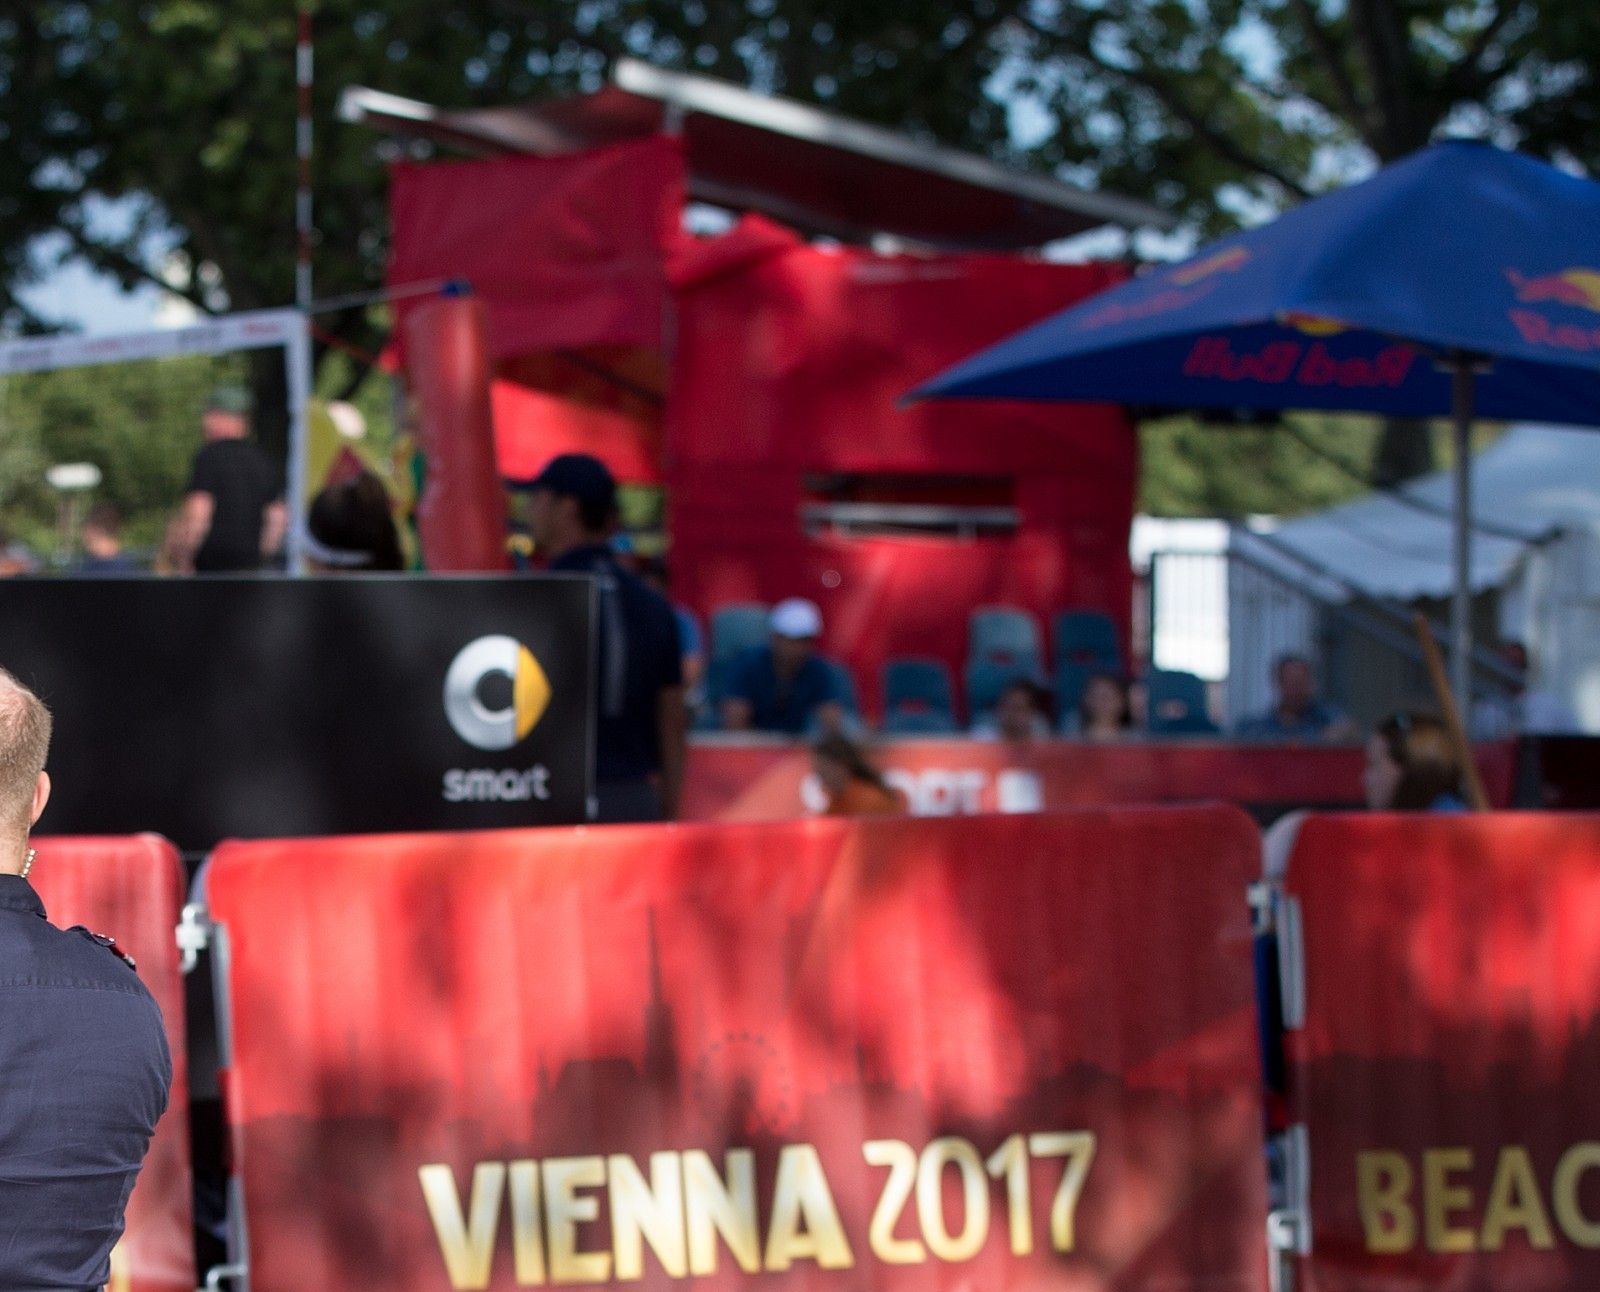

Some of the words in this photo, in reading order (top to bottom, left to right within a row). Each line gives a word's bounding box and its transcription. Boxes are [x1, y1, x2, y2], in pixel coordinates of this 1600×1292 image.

[443, 764, 549, 802] smart
[418, 1144, 855, 1292] VIENNA
[862, 1130, 1094, 1264] 2017
